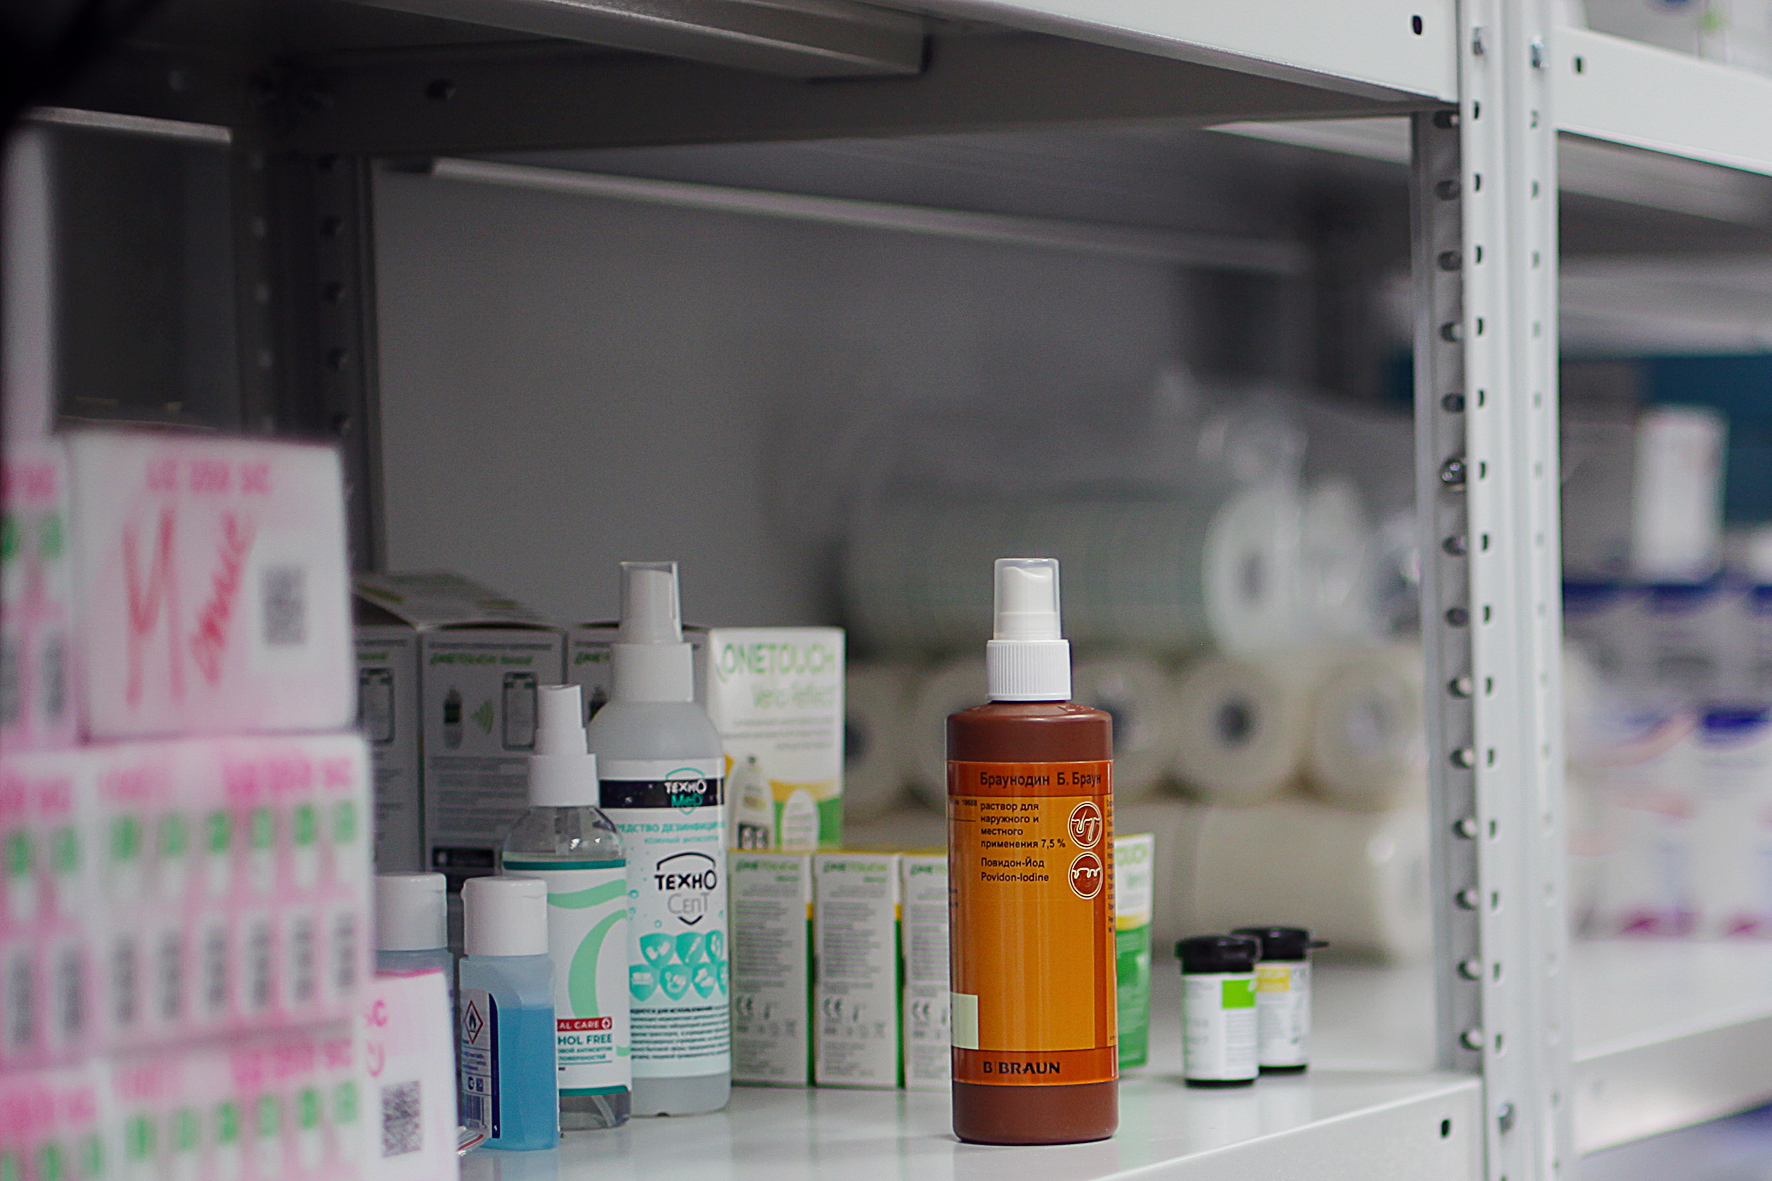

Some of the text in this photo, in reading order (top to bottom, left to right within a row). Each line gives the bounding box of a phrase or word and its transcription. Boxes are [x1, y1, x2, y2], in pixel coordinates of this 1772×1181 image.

[722, 643, 836, 674] ONETOUCH
[980, 772, 1102, 788] Браунодин Б. Браун
[980, 803, 1039, 812] раствор для
[980, 815, 1039, 825] наружного и
[980, 828, 1024, 836] местного
[980, 839, 1066, 850] применения 7,5 %
[980, 856, 1045, 869] Повидон-Йод
[654, 870, 717, 891] ТЕХНО
[981, 873, 1050, 882] Povidon-Iodine
[559, 1020, 599, 1030] AL CARE
[557, 1033, 612, 1046] HOL FREE
[983, 1061, 1061, 1074] B BRAUN
